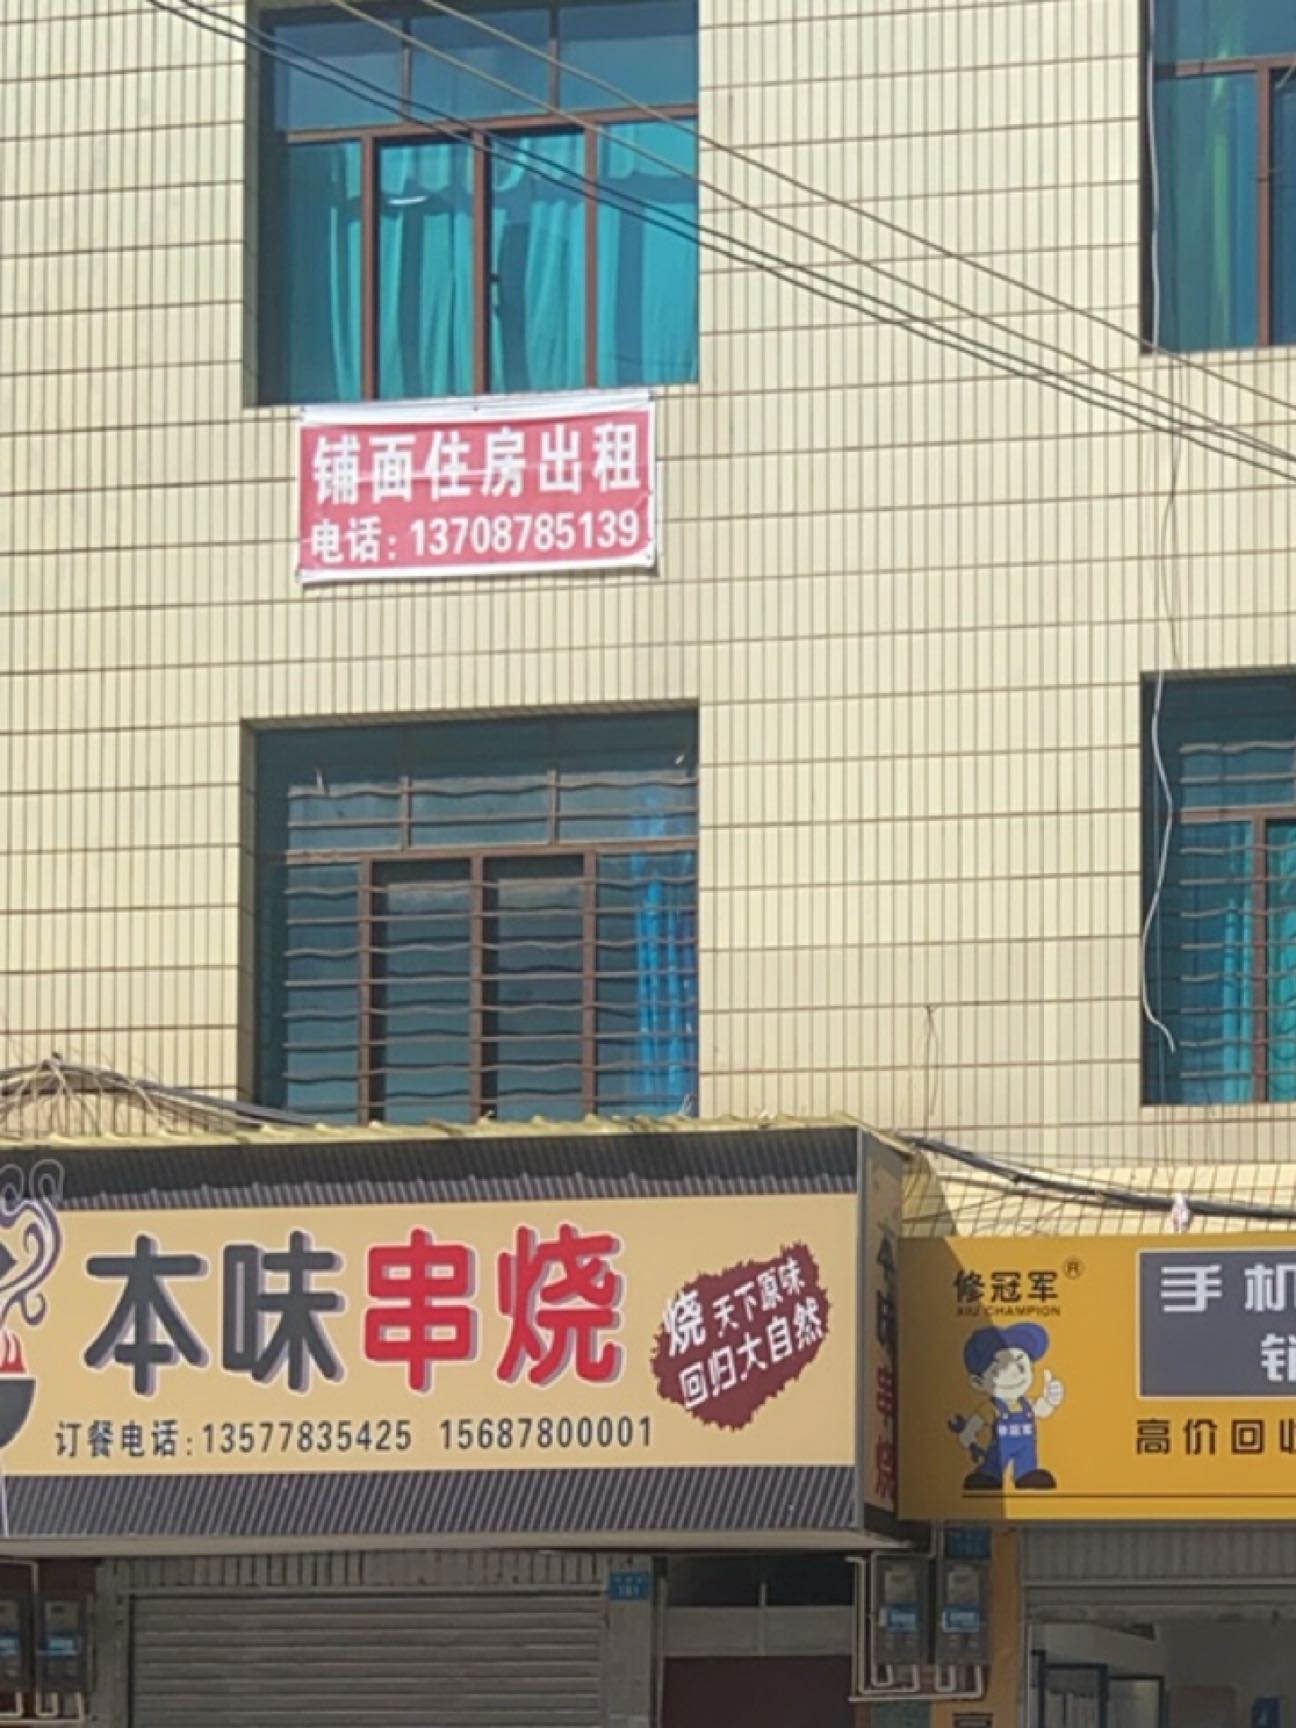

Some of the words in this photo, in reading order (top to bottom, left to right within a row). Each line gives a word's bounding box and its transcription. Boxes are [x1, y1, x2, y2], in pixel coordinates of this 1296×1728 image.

[313, 422, 640, 504] 铺面住房出租
[84, 1225, 628, 1395] 本味串烧
[953, 1269, 1059, 1303] 修冠军
[663, 1290, 707, 1357] 烧
[678, 1296, 824, 1409] 回归大自然
[440, 1416, 655, 1451] 15687800001
